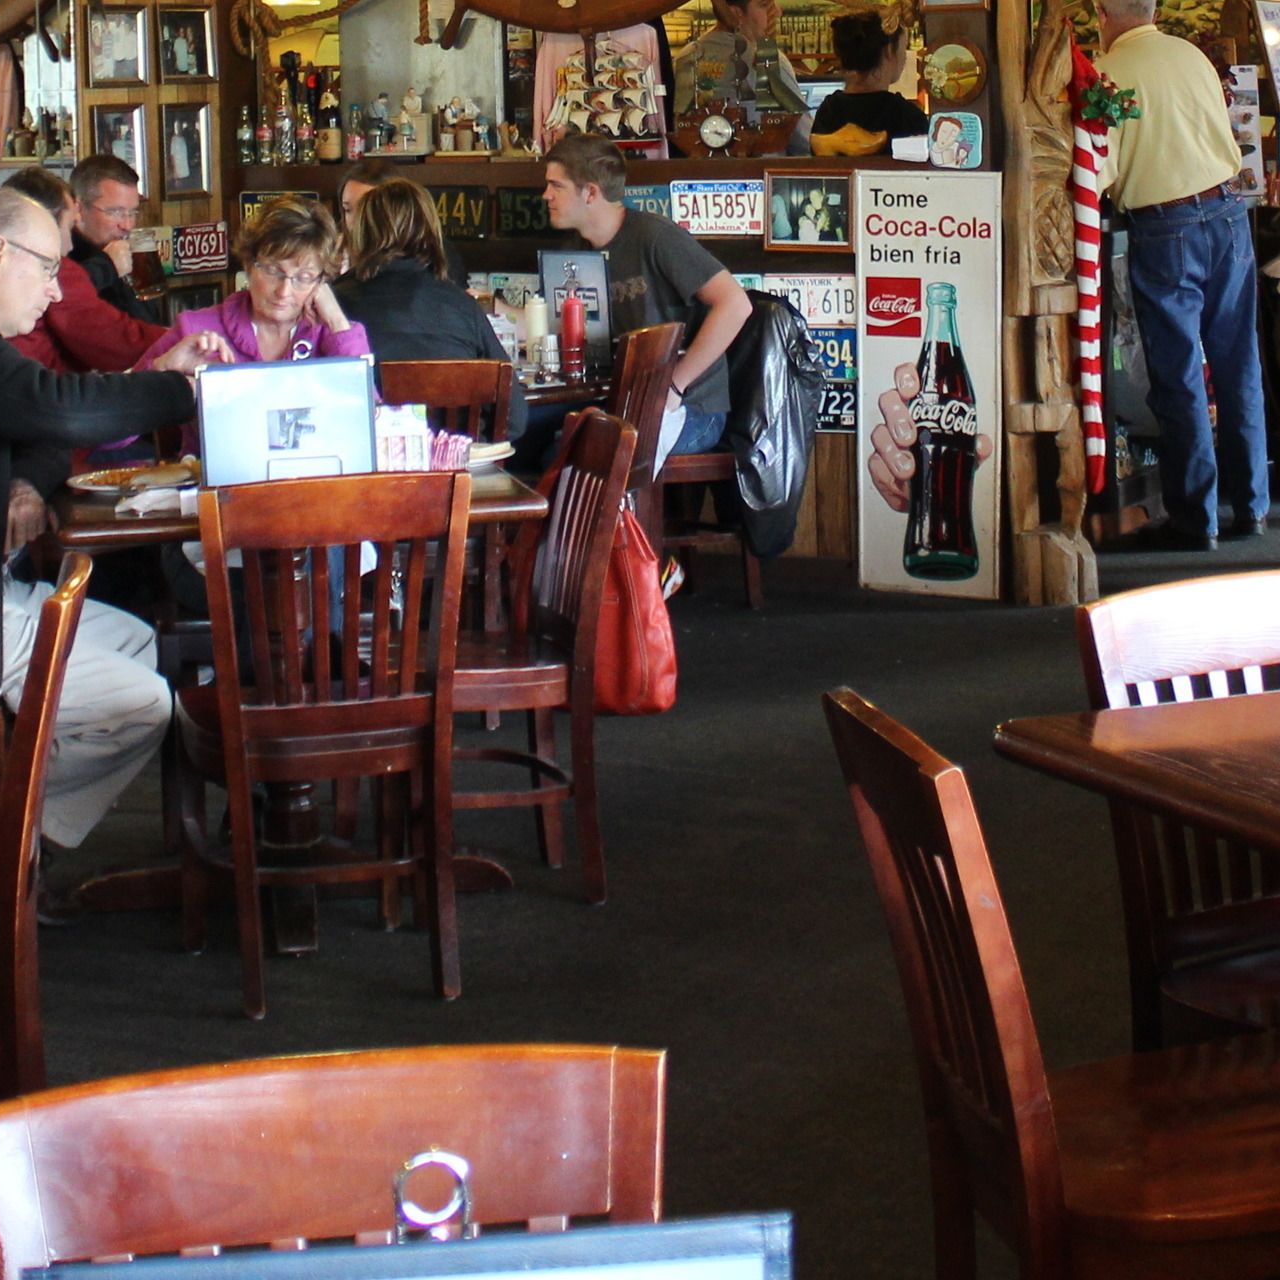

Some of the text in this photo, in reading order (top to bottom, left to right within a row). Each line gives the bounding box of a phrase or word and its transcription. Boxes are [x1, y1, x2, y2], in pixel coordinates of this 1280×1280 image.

[678, 194, 757, 219] 5A1585V
[870, 188, 928, 208] Tome
[695, 222, 741, 231] Alabama
[866, 214, 991, 239] Coca-Cola
[177, 233, 224, 257] CGY691
[870, 244, 914, 263] bien
[810, 278, 832, 286] YORK
[822, 289, 854, 315] 61B
